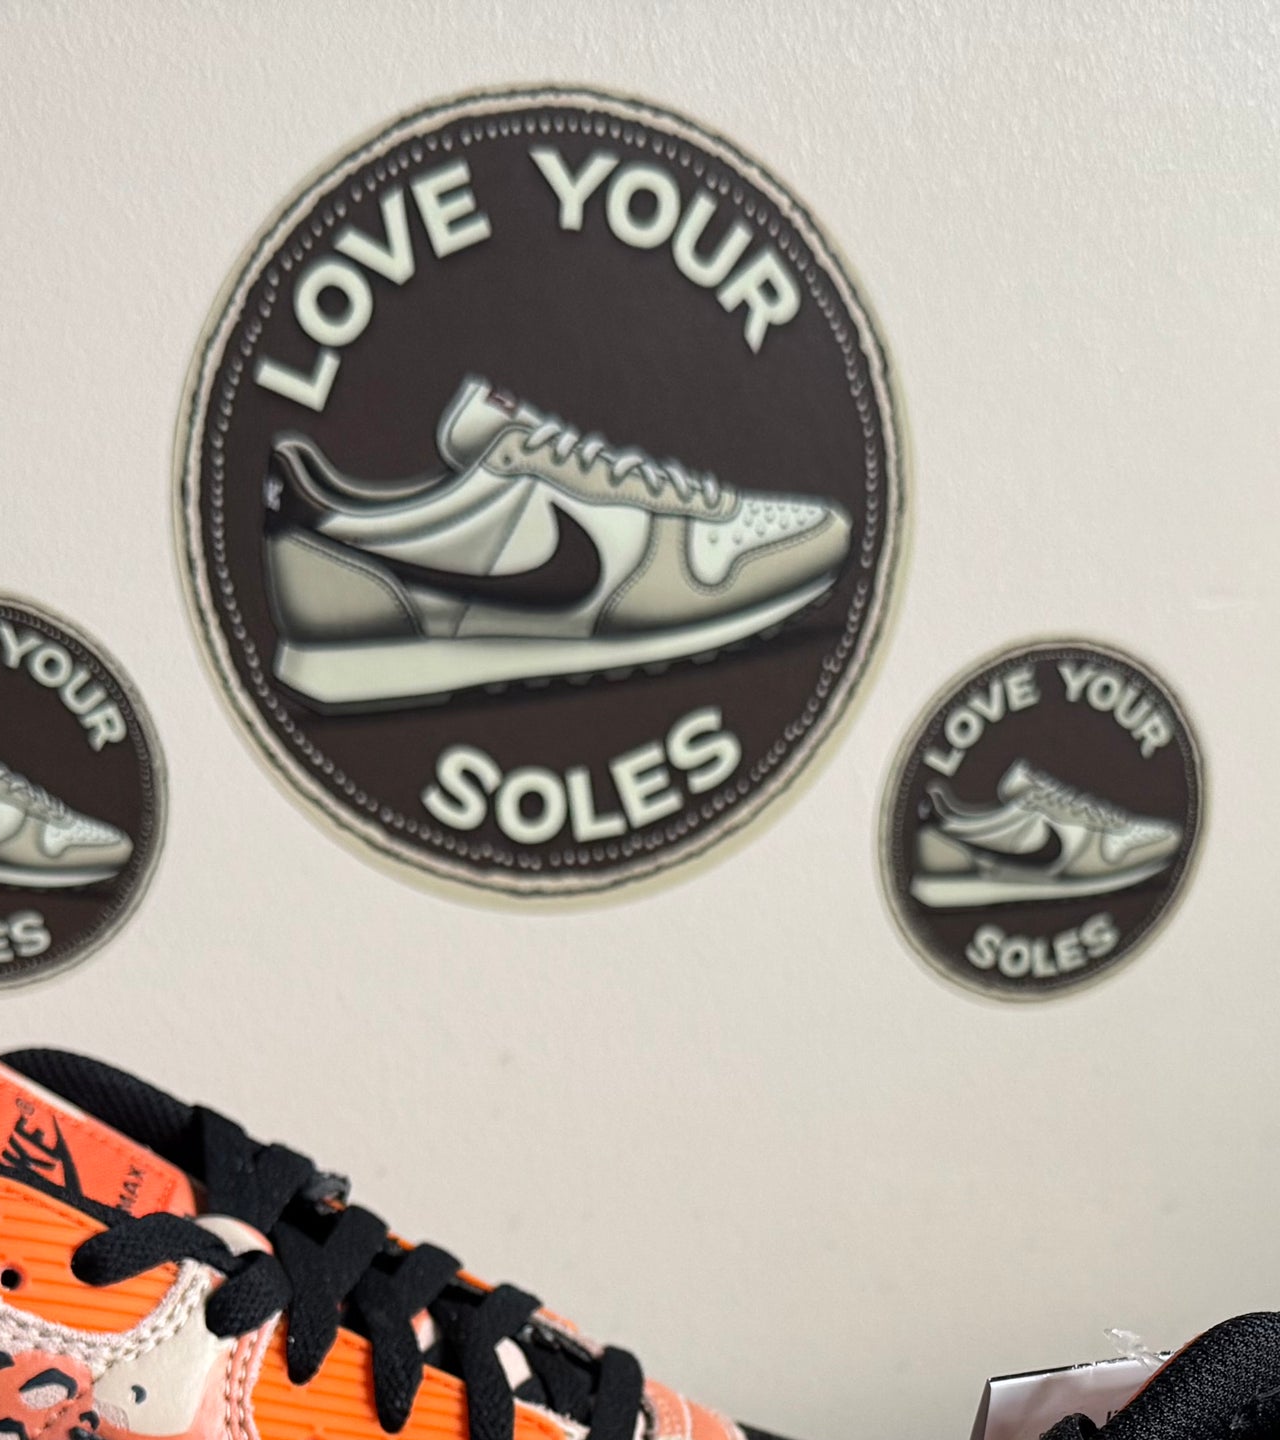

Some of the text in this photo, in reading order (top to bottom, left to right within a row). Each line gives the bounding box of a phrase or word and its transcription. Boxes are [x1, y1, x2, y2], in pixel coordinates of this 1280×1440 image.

[256, 145, 802, 412] LOVE YOUR
[422, 708, 742, 844] SOLES
[923, 662, 1173, 776] LOVE YOUR
[966, 914, 1118, 978] SOLES
